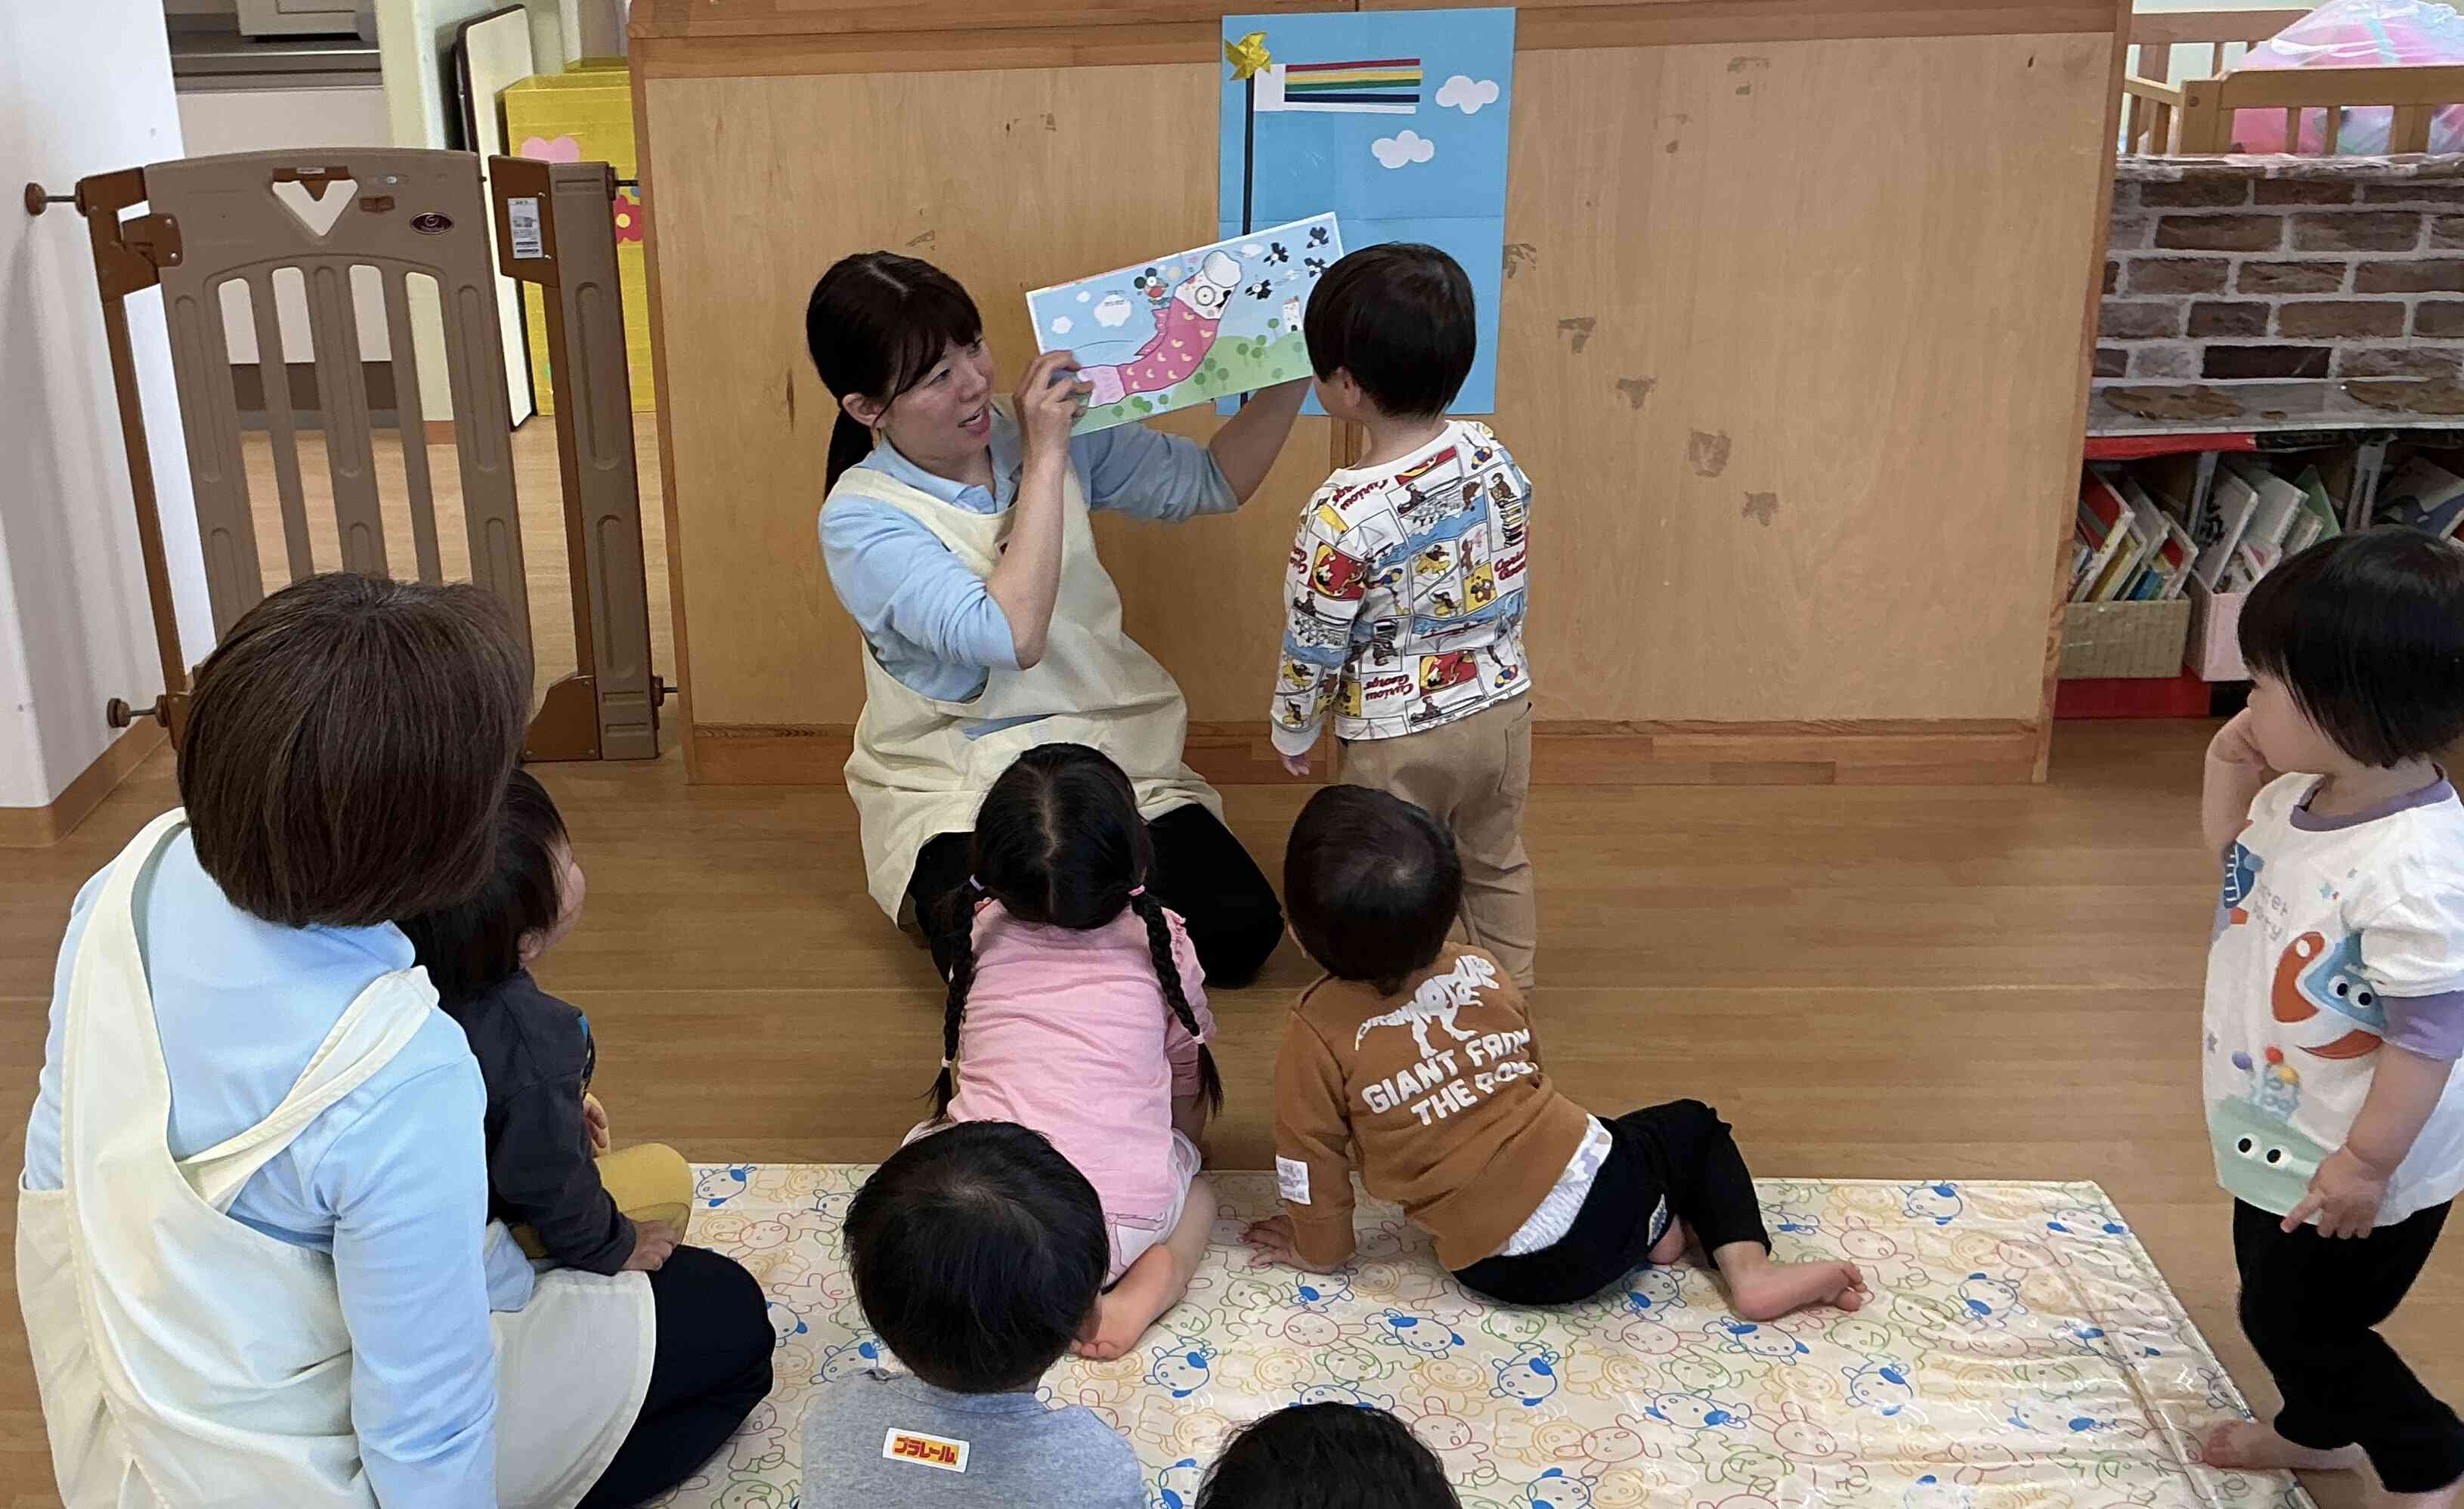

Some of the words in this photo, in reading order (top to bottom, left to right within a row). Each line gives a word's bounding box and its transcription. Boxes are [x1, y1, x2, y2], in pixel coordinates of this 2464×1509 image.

[1362, 1049, 1459, 1114] GIANT
[1410, 1078, 1478, 1126] THE
[894, 1436, 955, 1463] プラレール
